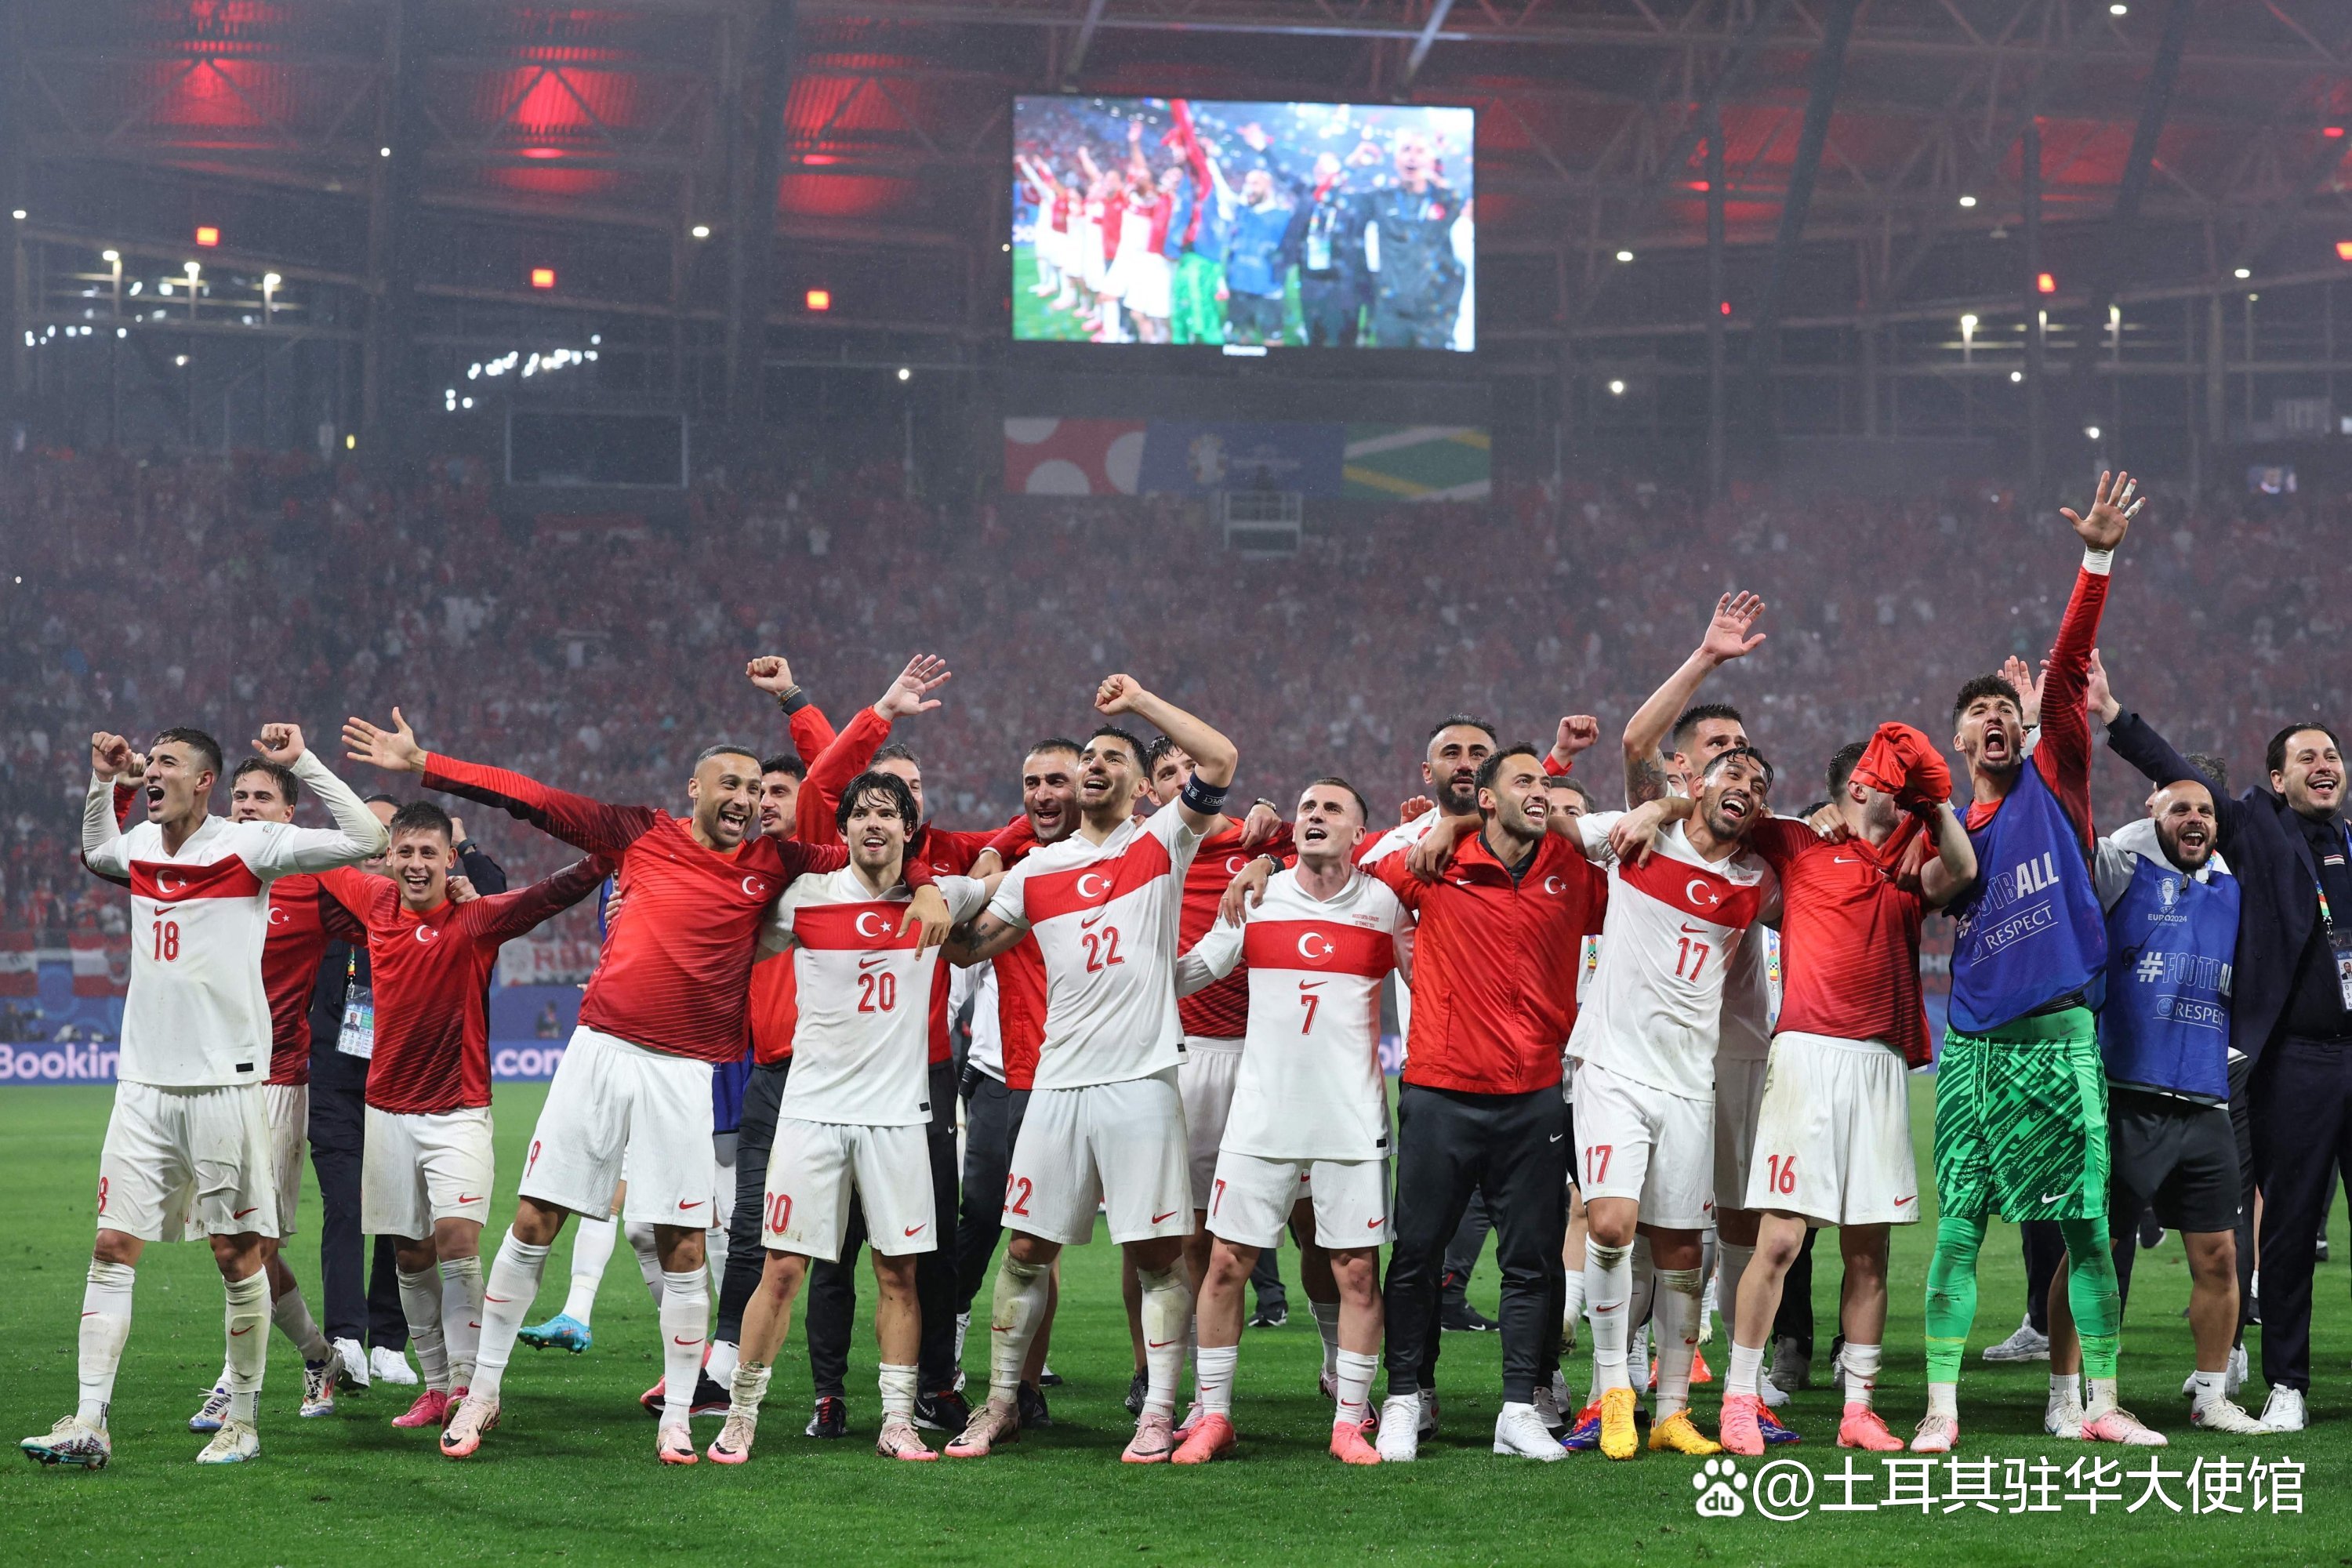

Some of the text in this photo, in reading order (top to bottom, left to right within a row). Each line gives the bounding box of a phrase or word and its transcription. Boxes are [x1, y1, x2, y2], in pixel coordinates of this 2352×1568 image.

[1985, 905, 2052, 949] RESPECT
[2148, 913, 2187, 923] EURO2024
[153, 920, 180, 963] 18
[1082, 926, 1125, 975] 22
[1675, 937, 1710, 983] 17
[858, 972, 897, 1014] 20
[2136, 951, 2233, 998] #FOOTBAL
[1301, 995, 1320, 1035] 7
[2175, 1003, 2225, 1027] RESPECT
[526, 1140, 541, 1179] 9
[1585, 1145, 1613, 1185] 17
[1768, 1154, 1797, 1194] 16
[765, 1192, 793, 1236] 20
[1213, 1178, 1226, 1218] 7
